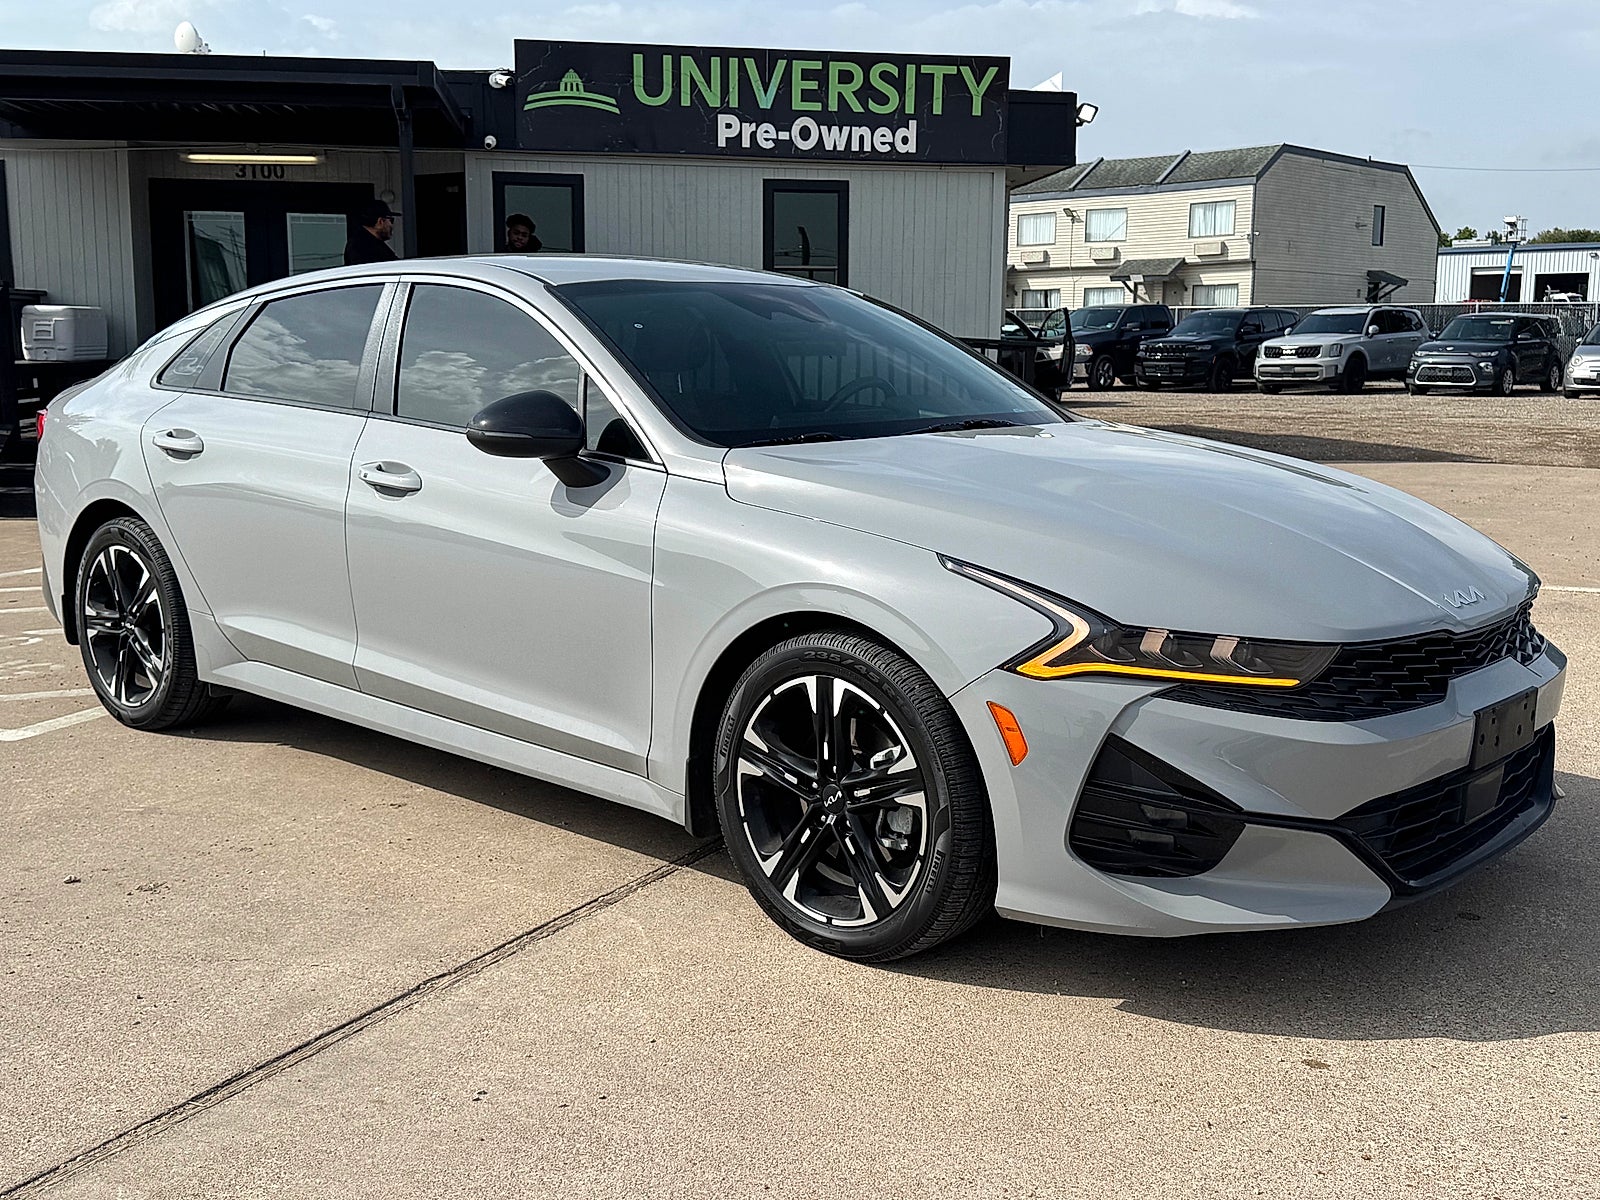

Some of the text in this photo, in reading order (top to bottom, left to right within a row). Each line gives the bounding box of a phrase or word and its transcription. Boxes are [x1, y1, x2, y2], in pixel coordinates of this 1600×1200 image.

[632, 53, 999, 116] UNIVERSITY
[717, 114, 918, 154] Pre-Owned
[235, 164, 285, 179] 3100
